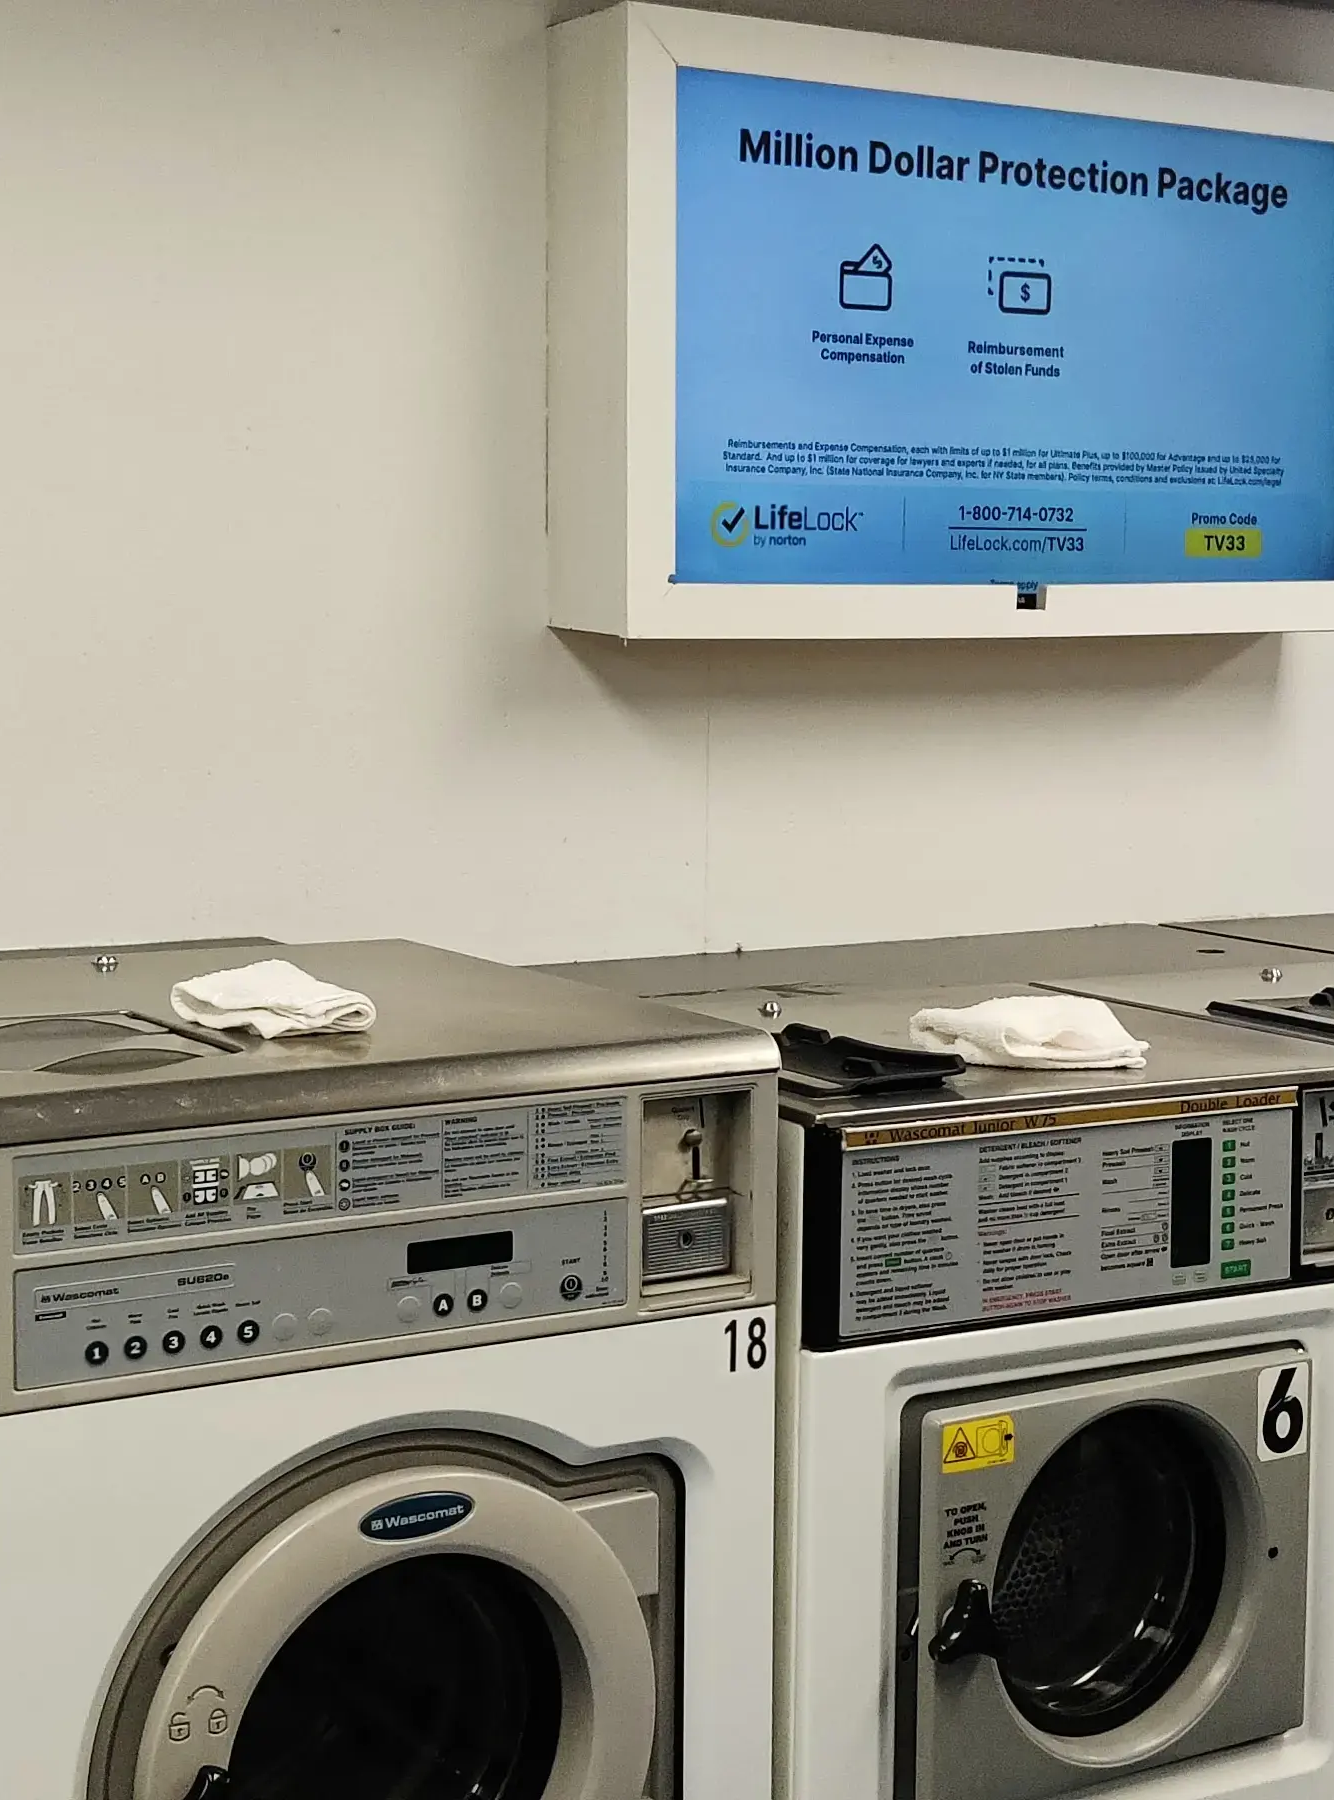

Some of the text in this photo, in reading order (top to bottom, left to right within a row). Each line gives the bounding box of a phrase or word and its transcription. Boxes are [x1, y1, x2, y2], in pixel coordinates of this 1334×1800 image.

[739, 128, 1288, 215] Million Dollar Protection Package
[812, 329, 915, 351] Personal Expense
[820, 347, 906, 367] Compensation
[967, 340, 1065, 360] Reimbursement
[970, 361, 1061, 379] of Stolen Funds
[728, 439, 796, 450] Reimbursements
[798, 442, 813, 450] and
[816, 442, 849, 453] Expense
[851, 443, 909, 455] Compensation,
[981, 449, 991, 457] up
[723, 451, 763, 461] Standard.
[767, 453, 783, 462] And
[784, 455, 796, 465] up
[797, 453, 806, 462] to
[846, 455, 857, 464] for
[859, 456, 896, 467] coverage
[897, 456, 908, 466] for
[725, 463, 766, 473] Insurance
[768, 464, 808, 476] Company,
[810, 465, 824, 475] Inc.
[852, 466, 884, 477] National
[926, 468, 964, 480] Company,
[754, 504, 859, 533] LifeLock
[958, 505, 1074, 523] 1-800-714-0732
[1191, 512, 1257, 526] Promo Code
[753, 534, 807, 548] by norton
[950, 534, 1085, 553] LifeLock.com/TV33
[1203, 534, 1246, 552] TV33
[1180, 1093, 1282, 1113] Double Loader
[445, 1116, 477, 1125] WARNING
[344, 1126, 373, 1135] SUPPLY
[375, 1125, 390, 1134] BOX
[889, 1120, 965, 1143] Wascomat
[972, 1117, 1017, 1134] Junior
[52, 1287, 119, 1303] Wascomat
[724, 1317, 767, 1372] 18
[1263, 1366, 1305, 1454] 6
[385, 1503, 465, 1529] Wascomat
[944, 1502, 987, 1517] TO OPEN,
[954, 1514, 979, 1526] PUSH
[946, 1523, 985, 1538] KNOB IN
[943, 1533, 988, 1549] AND TURN
